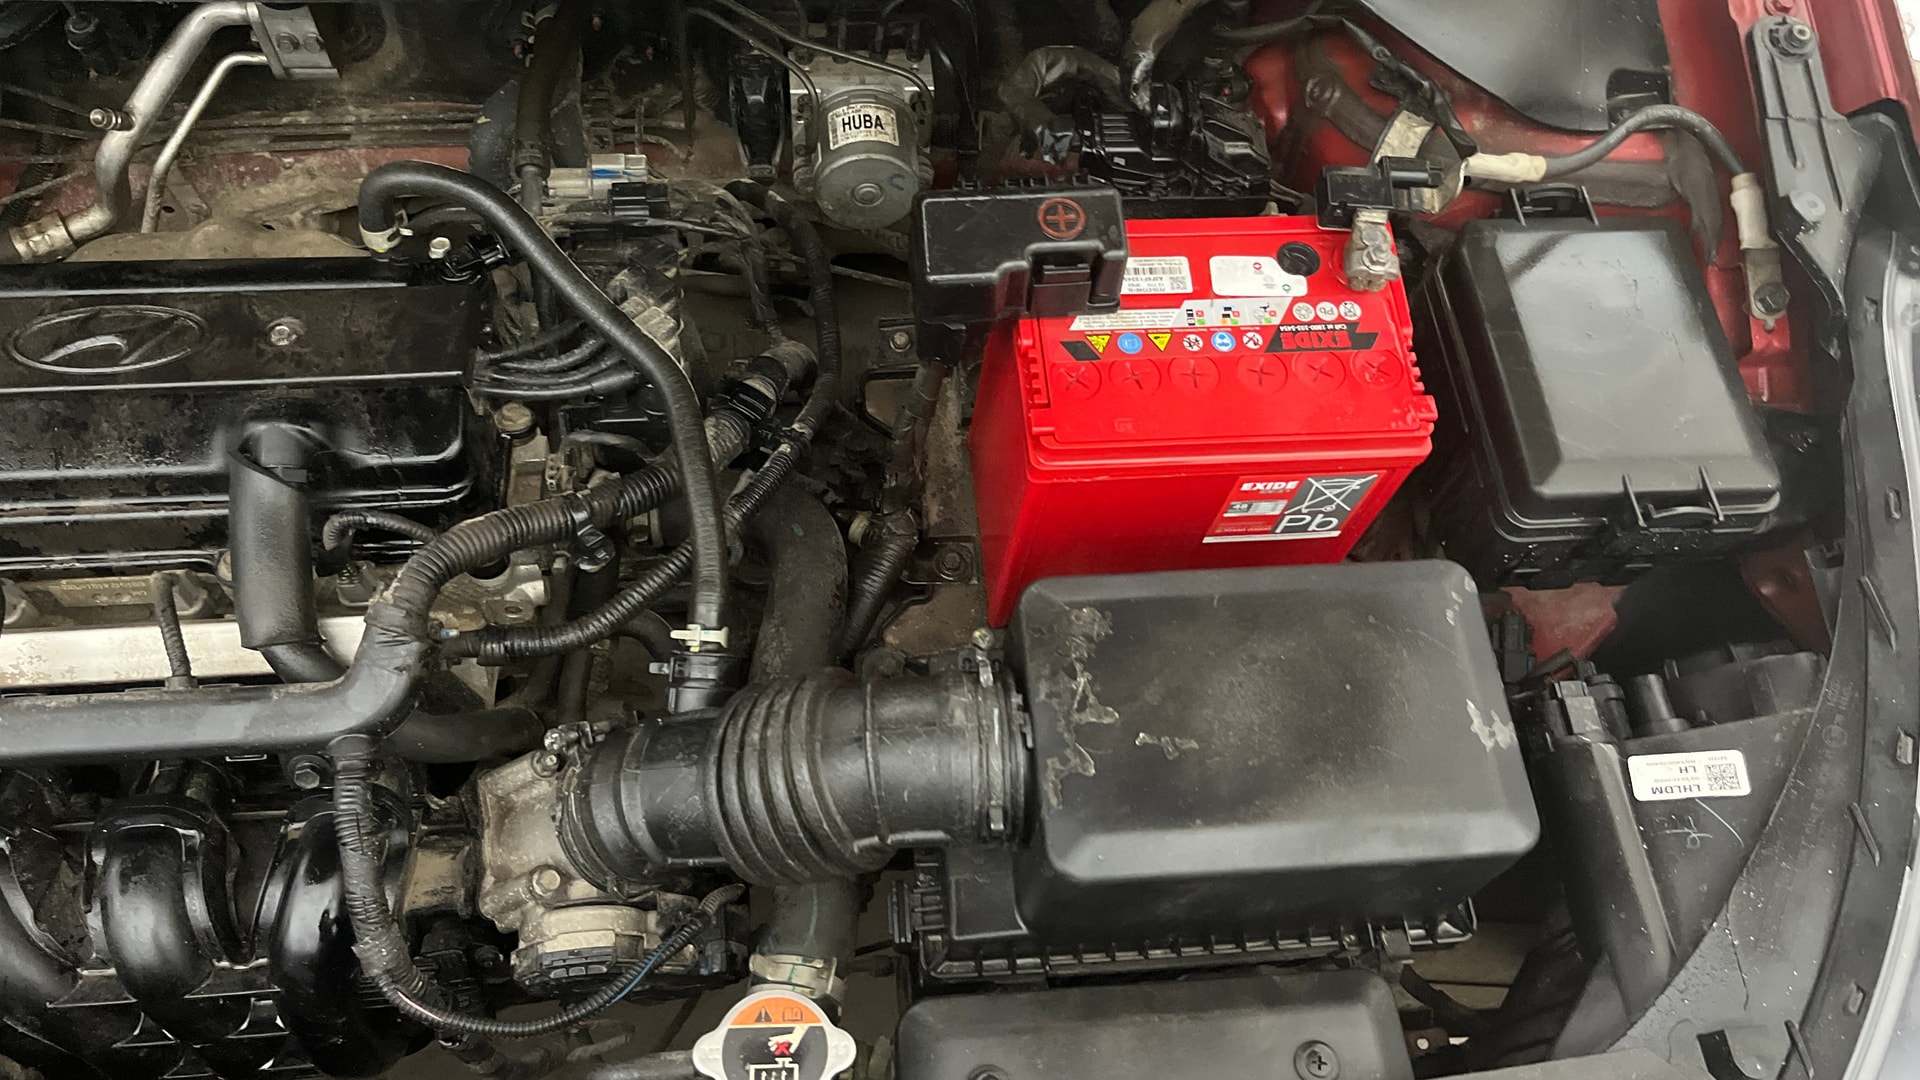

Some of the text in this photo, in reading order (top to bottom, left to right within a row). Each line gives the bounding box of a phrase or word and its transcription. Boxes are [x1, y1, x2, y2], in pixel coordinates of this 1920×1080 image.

[842, 114, 885, 133] HUBA
[1333, 323, 1348, 331] Call
[1280, 331, 1353, 350] EXIDE
[1240, 480, 1299, 491] EXIDE
[1275, 513, 1340, 534] Pb
[1678, 765, 1697, 774] LH
[1651, 784, 1701, 795] LHLDM
